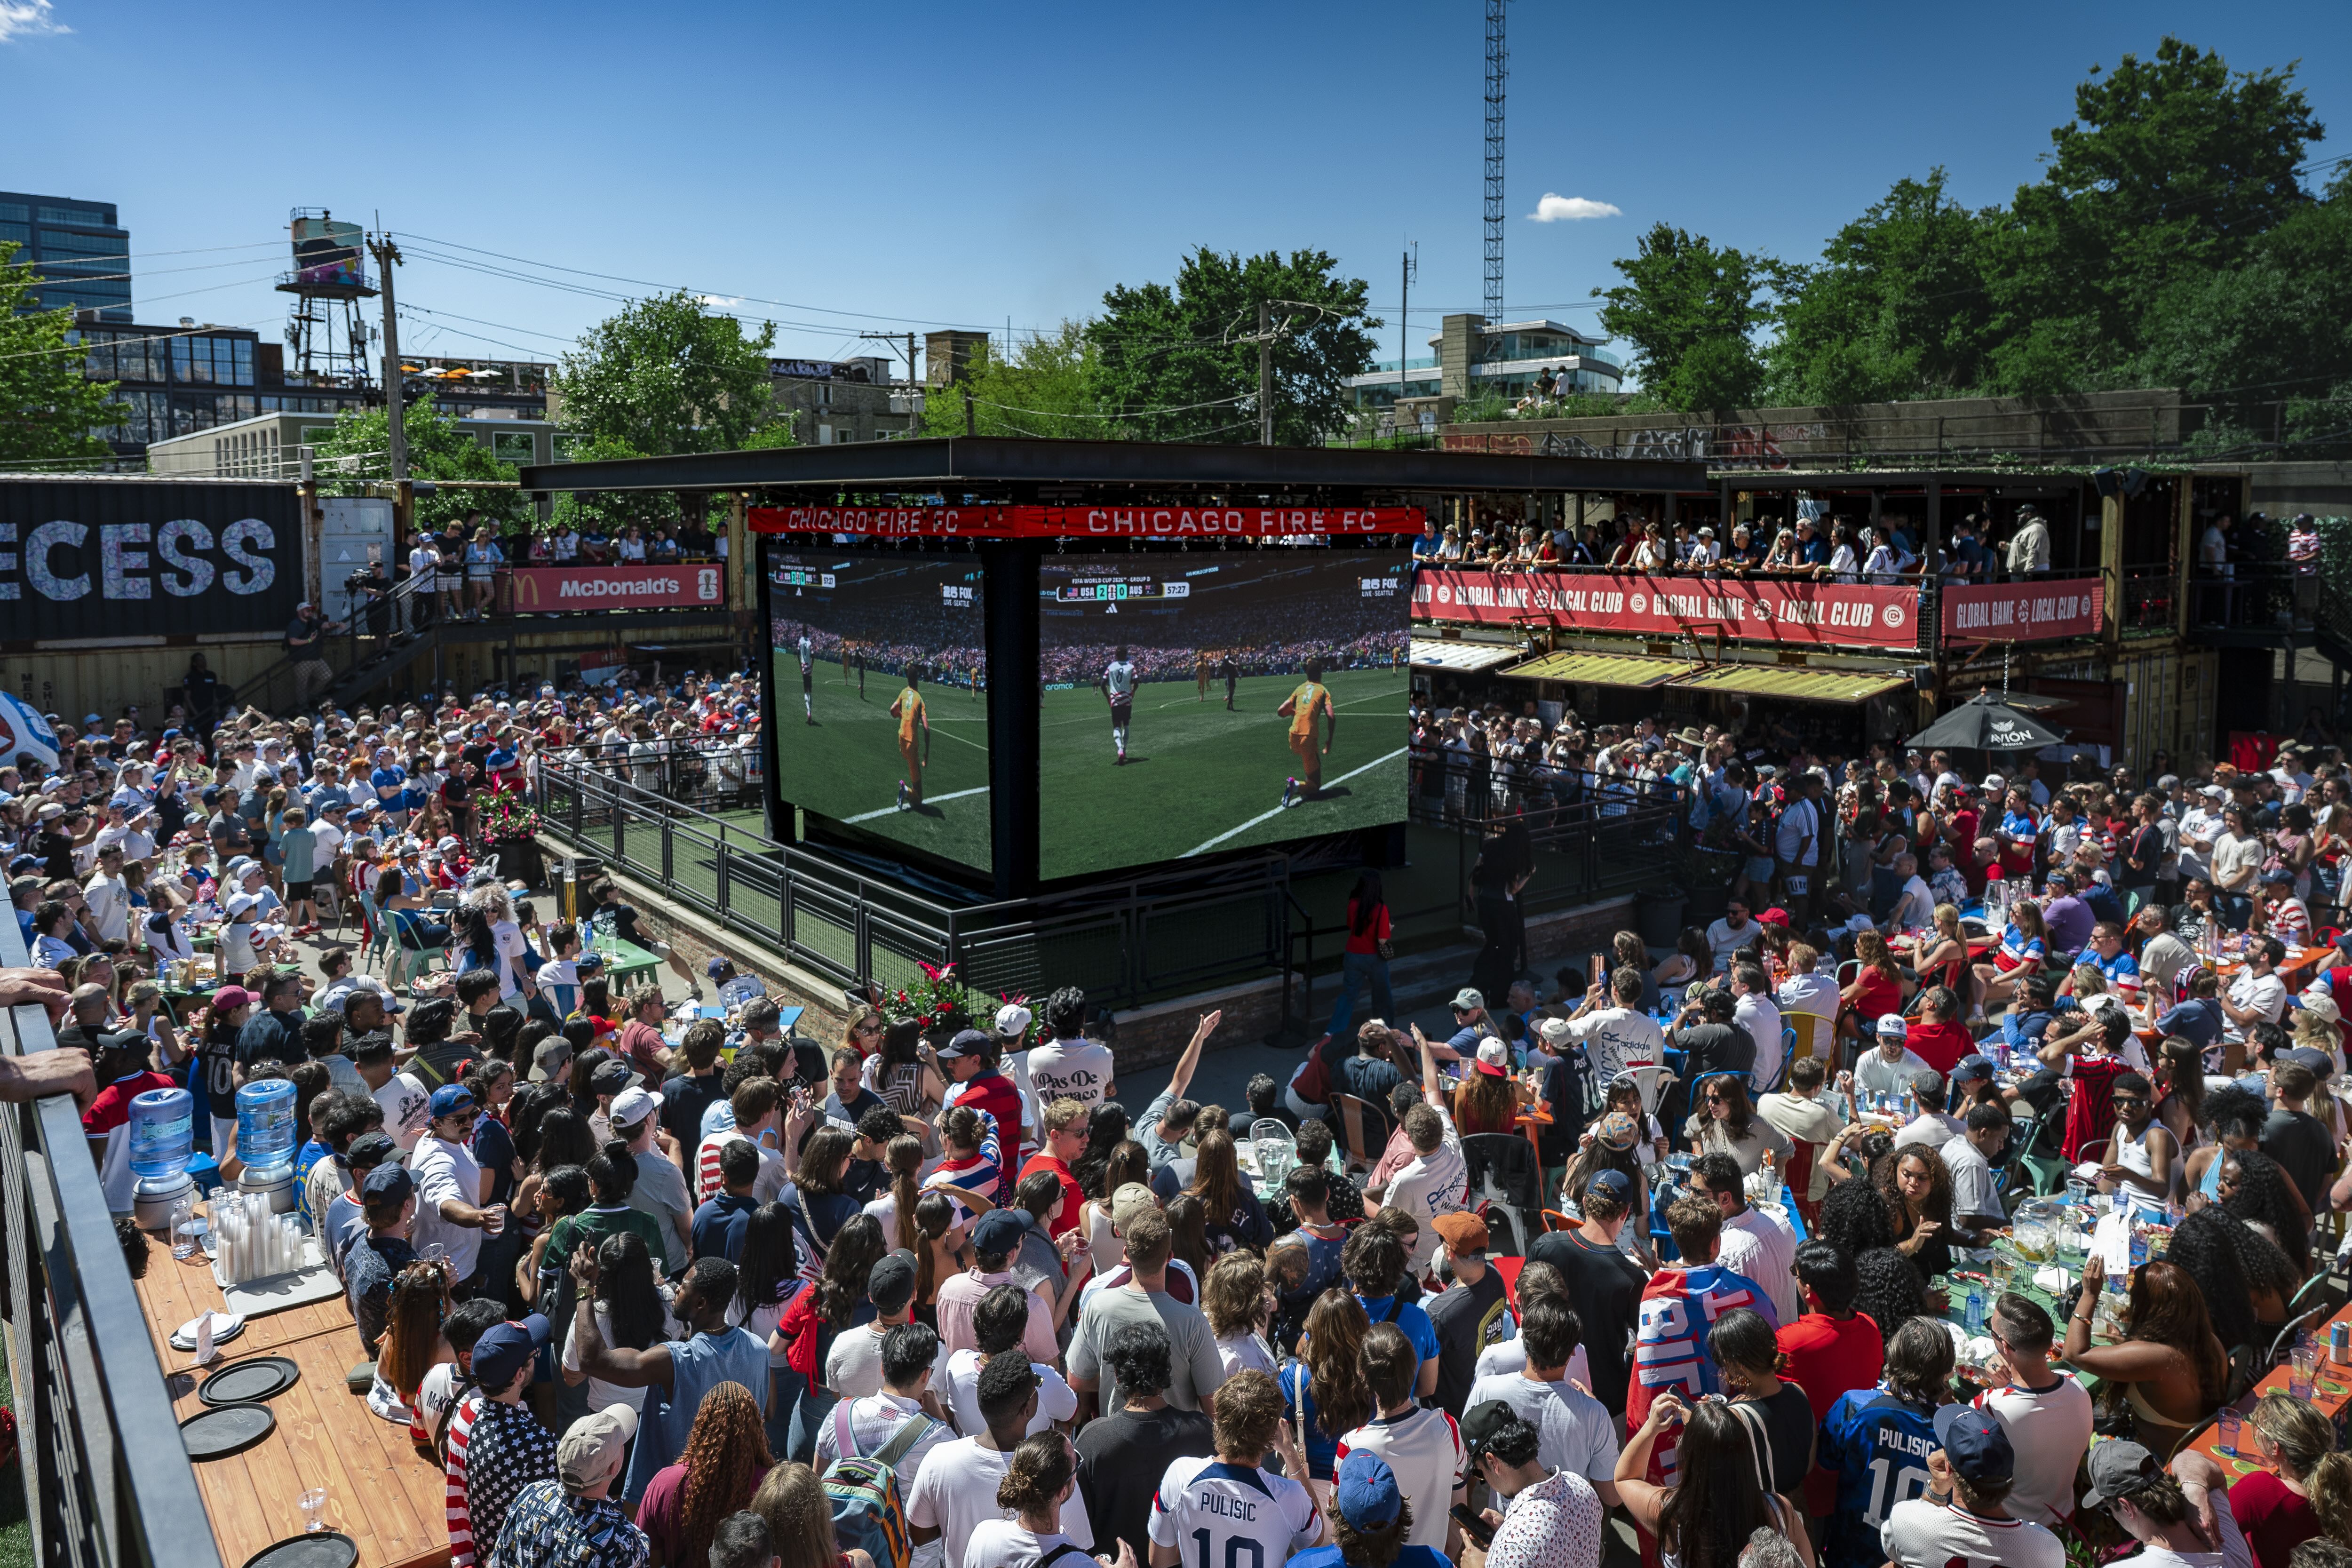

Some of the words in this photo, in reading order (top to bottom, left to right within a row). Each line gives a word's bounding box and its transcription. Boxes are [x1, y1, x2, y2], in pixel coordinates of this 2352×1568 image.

[789, 510, 866, 531] CHICAGO
[877, 511, 921, 533] FIRE
[933, 510, 958, 533] FC
[1088, 510, 1242, 532] CHICAGO
[1261, 511, 1325, 532] FIRE
[1343, 511, 1375, 531] FC
[560, 578, 680, 597] McDonald's
[959, 587, 972, 599] FOX
[1081, 587, 1095, 597] USA
[1100, 588, 1104, 597] 2
[1120, 587, 1124, 596] 0
[1129, 585, 1143, 595] AUS
[1383, 578, 1398, 589] FOX
[1412, 584, 1432, 603] LUB
[1455, 585, 1495, 606] GLOBAL
[1498, 587, 1528, 608] GAME
[1550, 590, 1587, 611] LOCAL
[1590, 591, 1624, 613] CLUB
[1653, 594, 1703, 618] GLOBAL
[1707, 597, 1746, 621] GAME
[1778, 599, 1825, 625] LOCAL
[1830, 602, 1874, 627] CLUB
[1957, 602, 1990, 629] GLOBAL
[1992, 600, 2015, 626] GAME
[2031, 597, 2056, 622] LOCAL
[2058, 596, 2078, 620] CLUB
[1045, 683, 1074, 691] aramco
[1621, 1041, 1650, 1051] adidas
[207, 1055, 232, 1095] 10
[1038, 1072, 1069, 1089] Pas
[1071, 1070, 1098, 1087] De
[826, 1114, 840, 1128] UNITED
[839, 1118, 858, 1132] STATES
[1486, 1318, 1502, 1339] Stag
[1879, 1427, 1936, 1458] PULISIC
[1200, 1492, 1256, 1522] PULISIC
